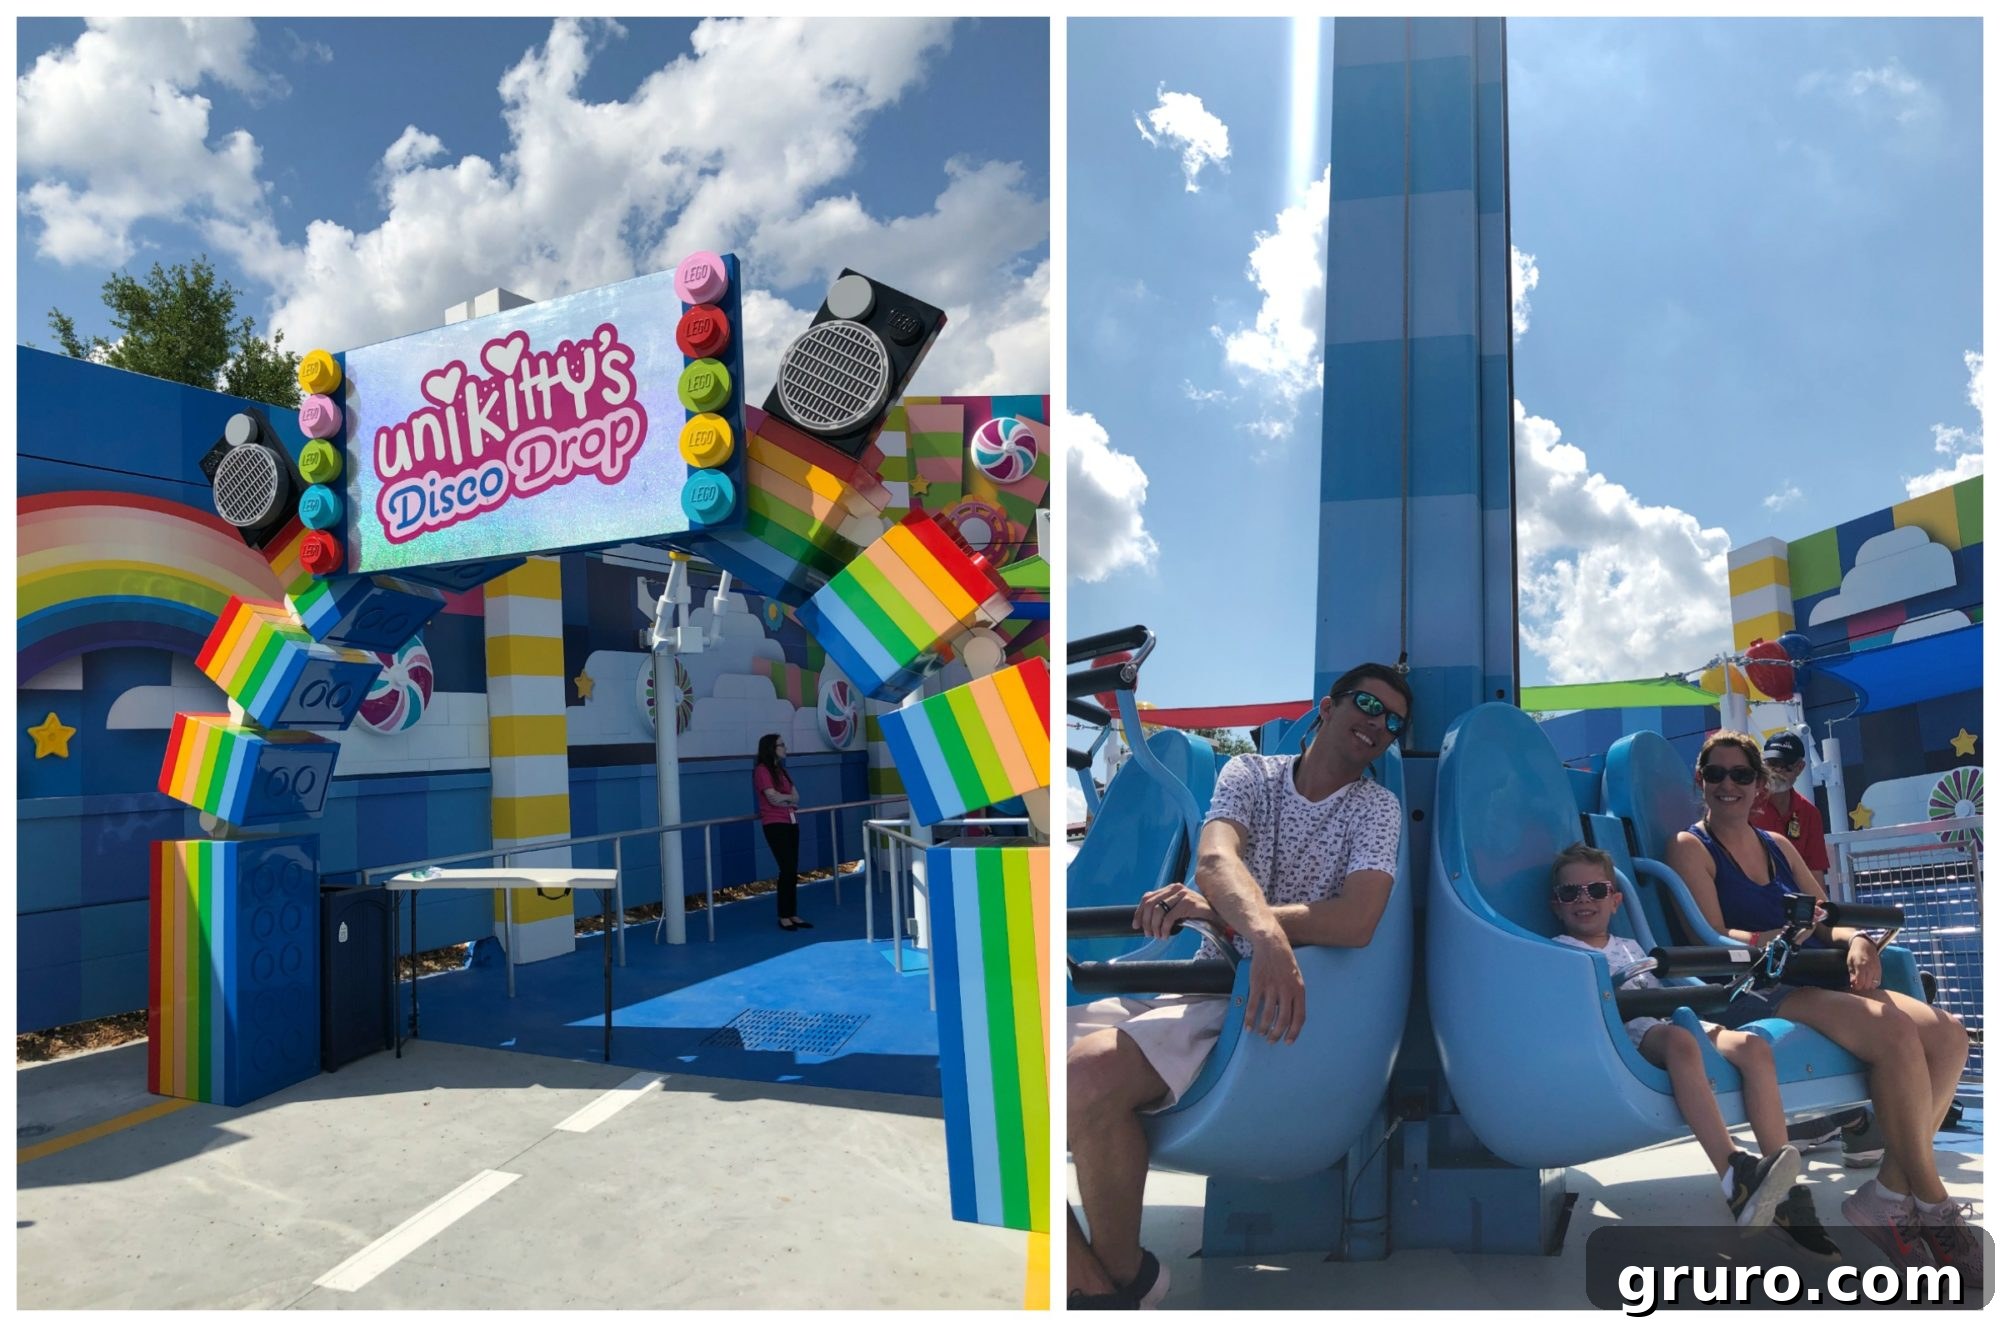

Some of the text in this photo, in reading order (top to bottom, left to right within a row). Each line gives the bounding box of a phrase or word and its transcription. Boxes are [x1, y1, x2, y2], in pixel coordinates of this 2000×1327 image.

[684, 264, 709, 284] LEGO
[686, 318, 711, 338] LEGO
[688, 373, 712, 393] LEGO
[689, 430, 714, 448] LEGO
[388, 415, 634, 531] Disco Drop
[691, 486, 716, 503] LEGO
